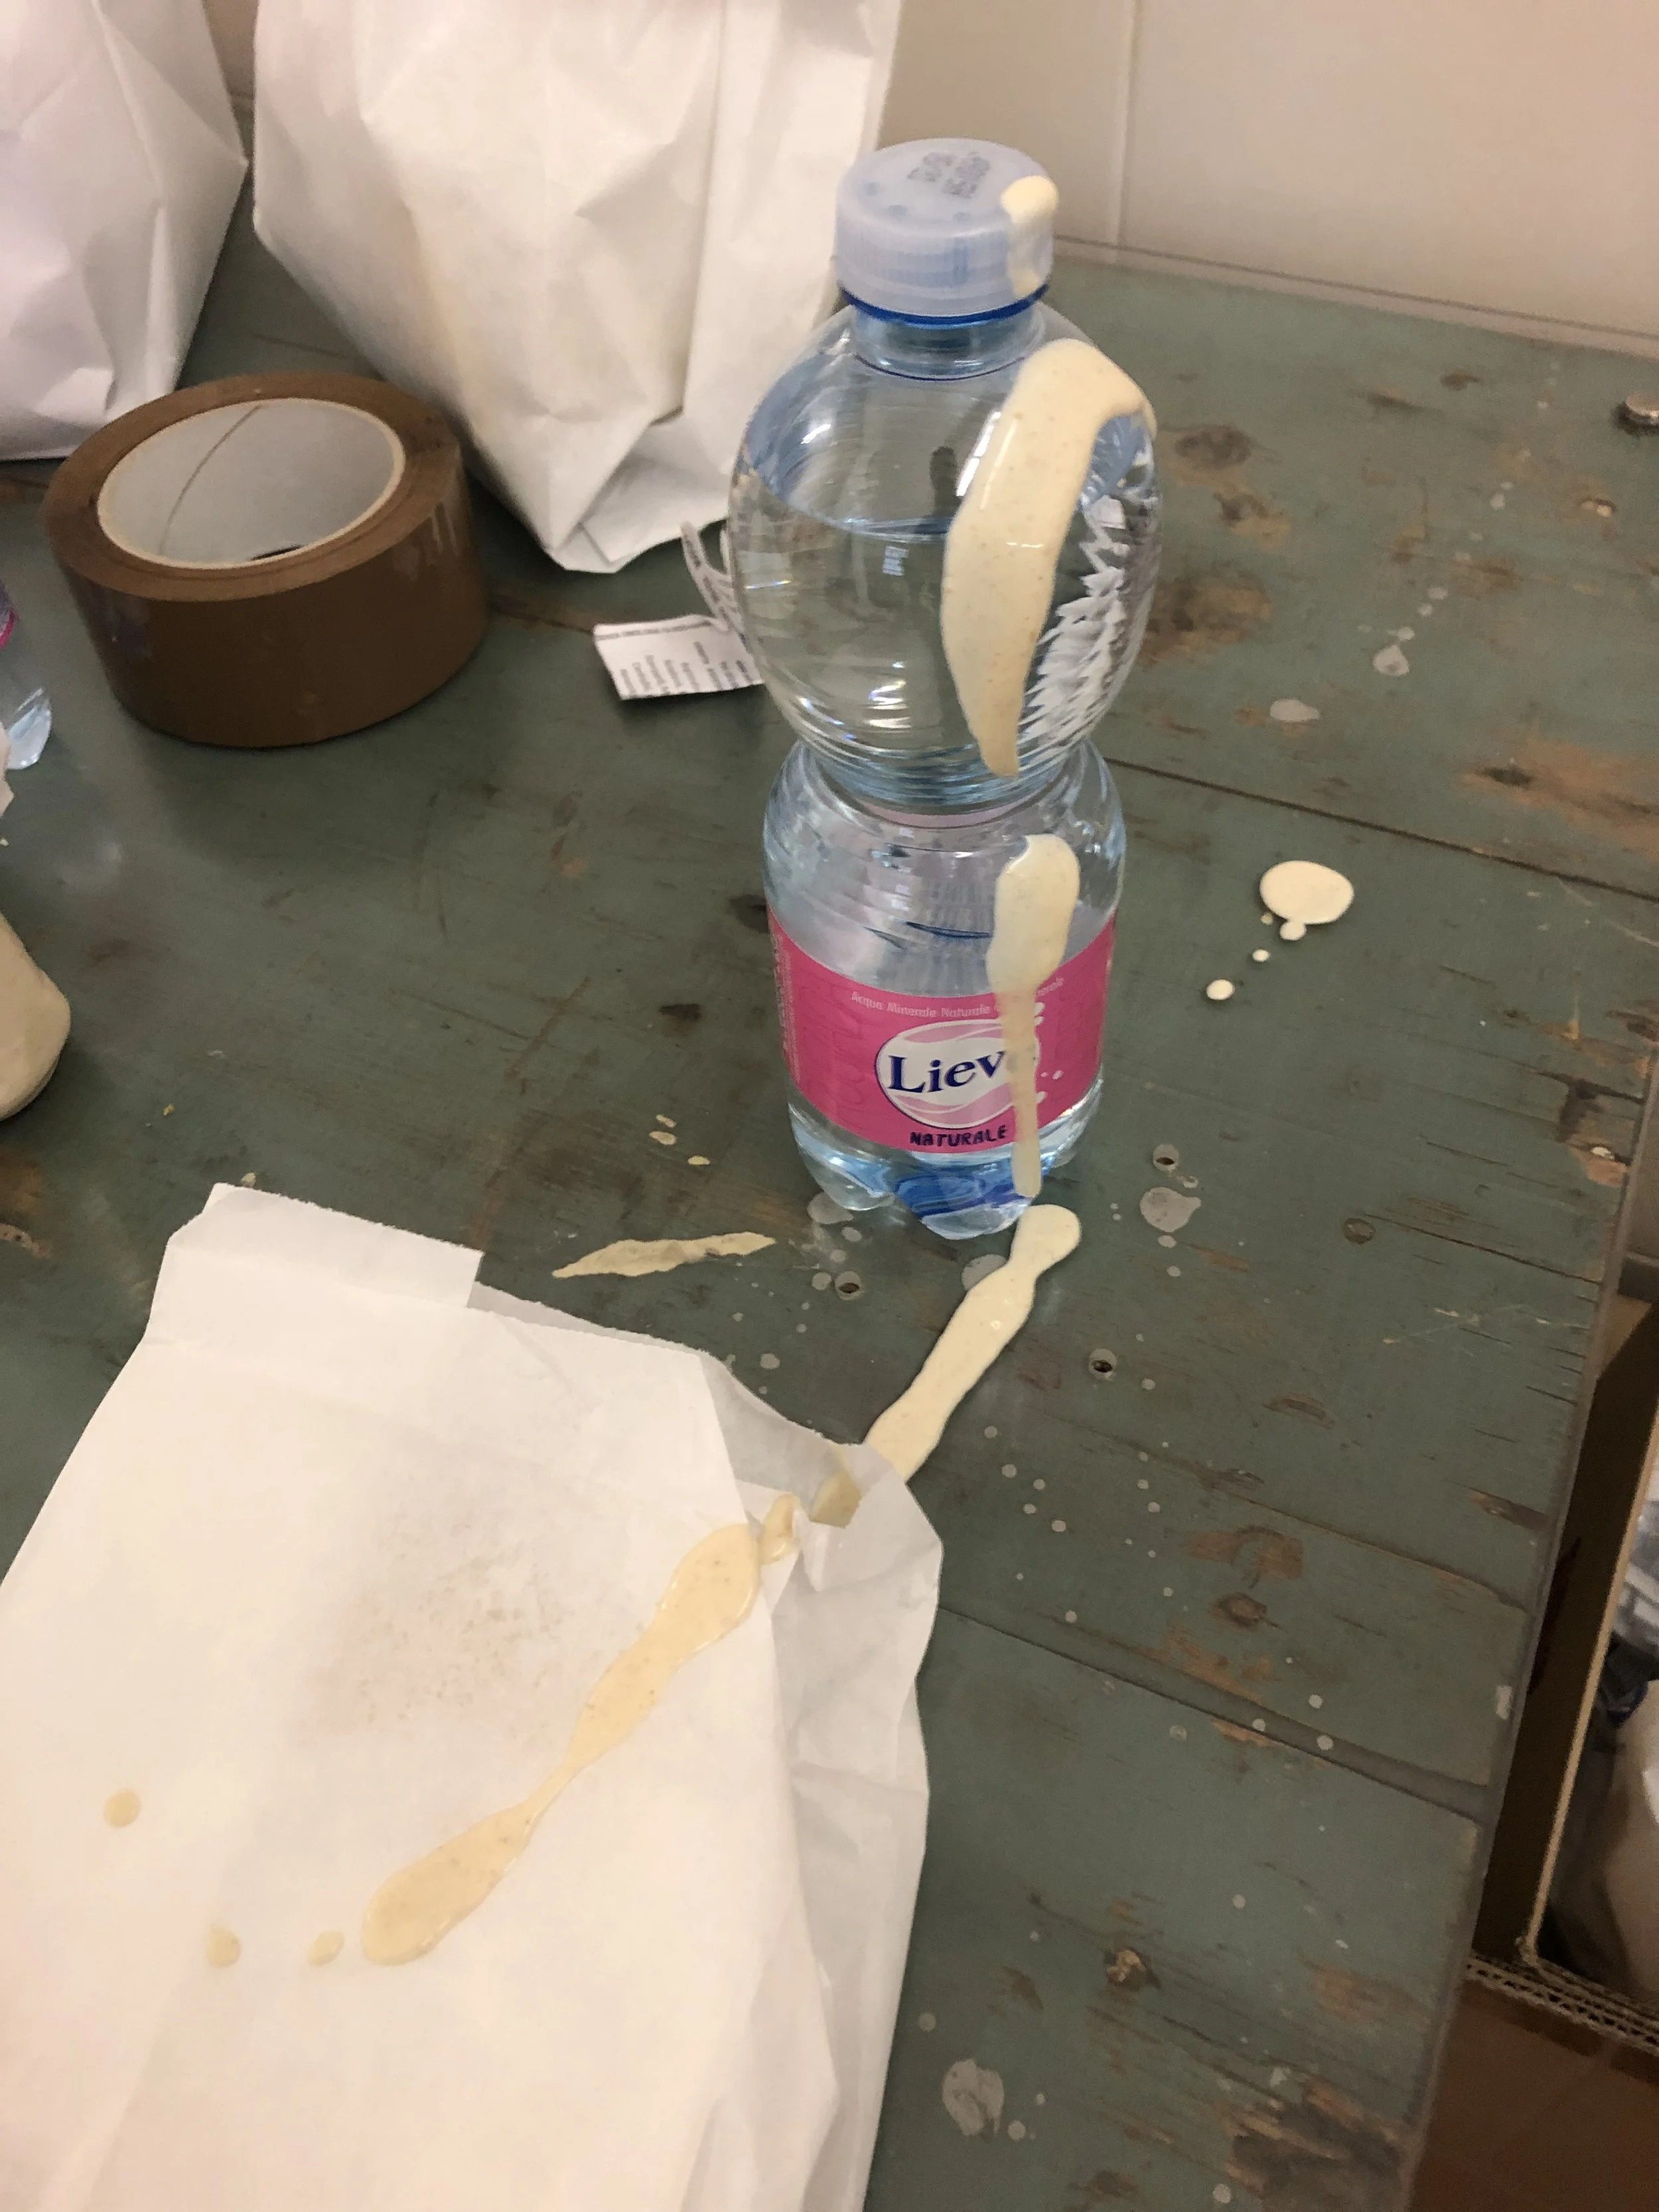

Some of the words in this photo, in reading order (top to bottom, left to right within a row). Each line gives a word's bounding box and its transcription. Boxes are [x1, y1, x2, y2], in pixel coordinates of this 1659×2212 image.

[851, 991, 883, 1009] Acqua
[887, 1001, 937, 1017] Minerale
[941, 1004, 990, 1017] Naturale
[888, 1051, 1011, 1093] Liev
[910, 1124, 1007, 1147] NATURALE
